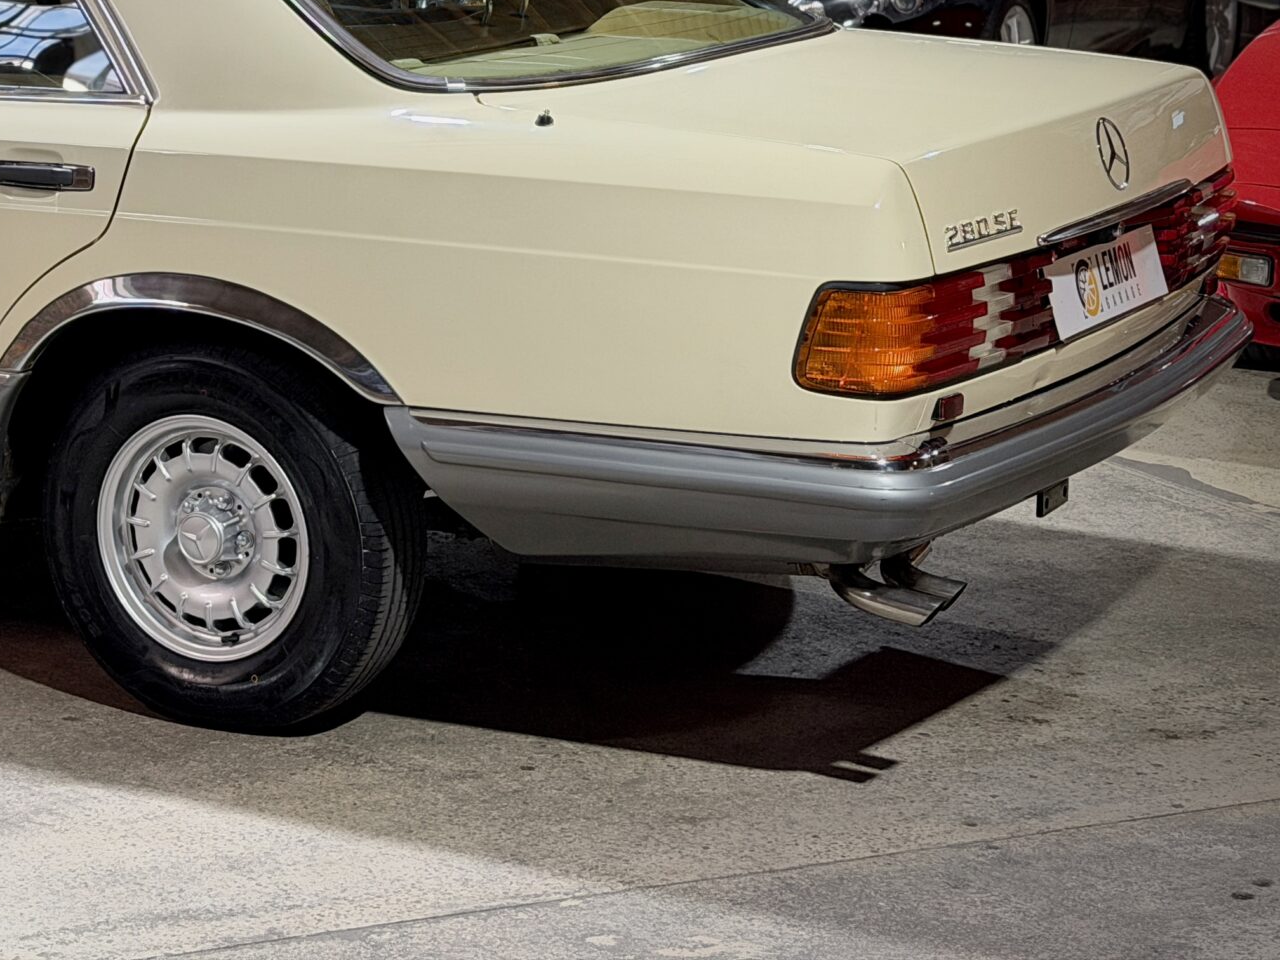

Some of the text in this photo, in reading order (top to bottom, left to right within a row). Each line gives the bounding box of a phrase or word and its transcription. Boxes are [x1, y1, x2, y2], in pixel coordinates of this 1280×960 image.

[944, 209, 1020, 247] 280 SE
[1095, 242, 1137, 291] LEMON
